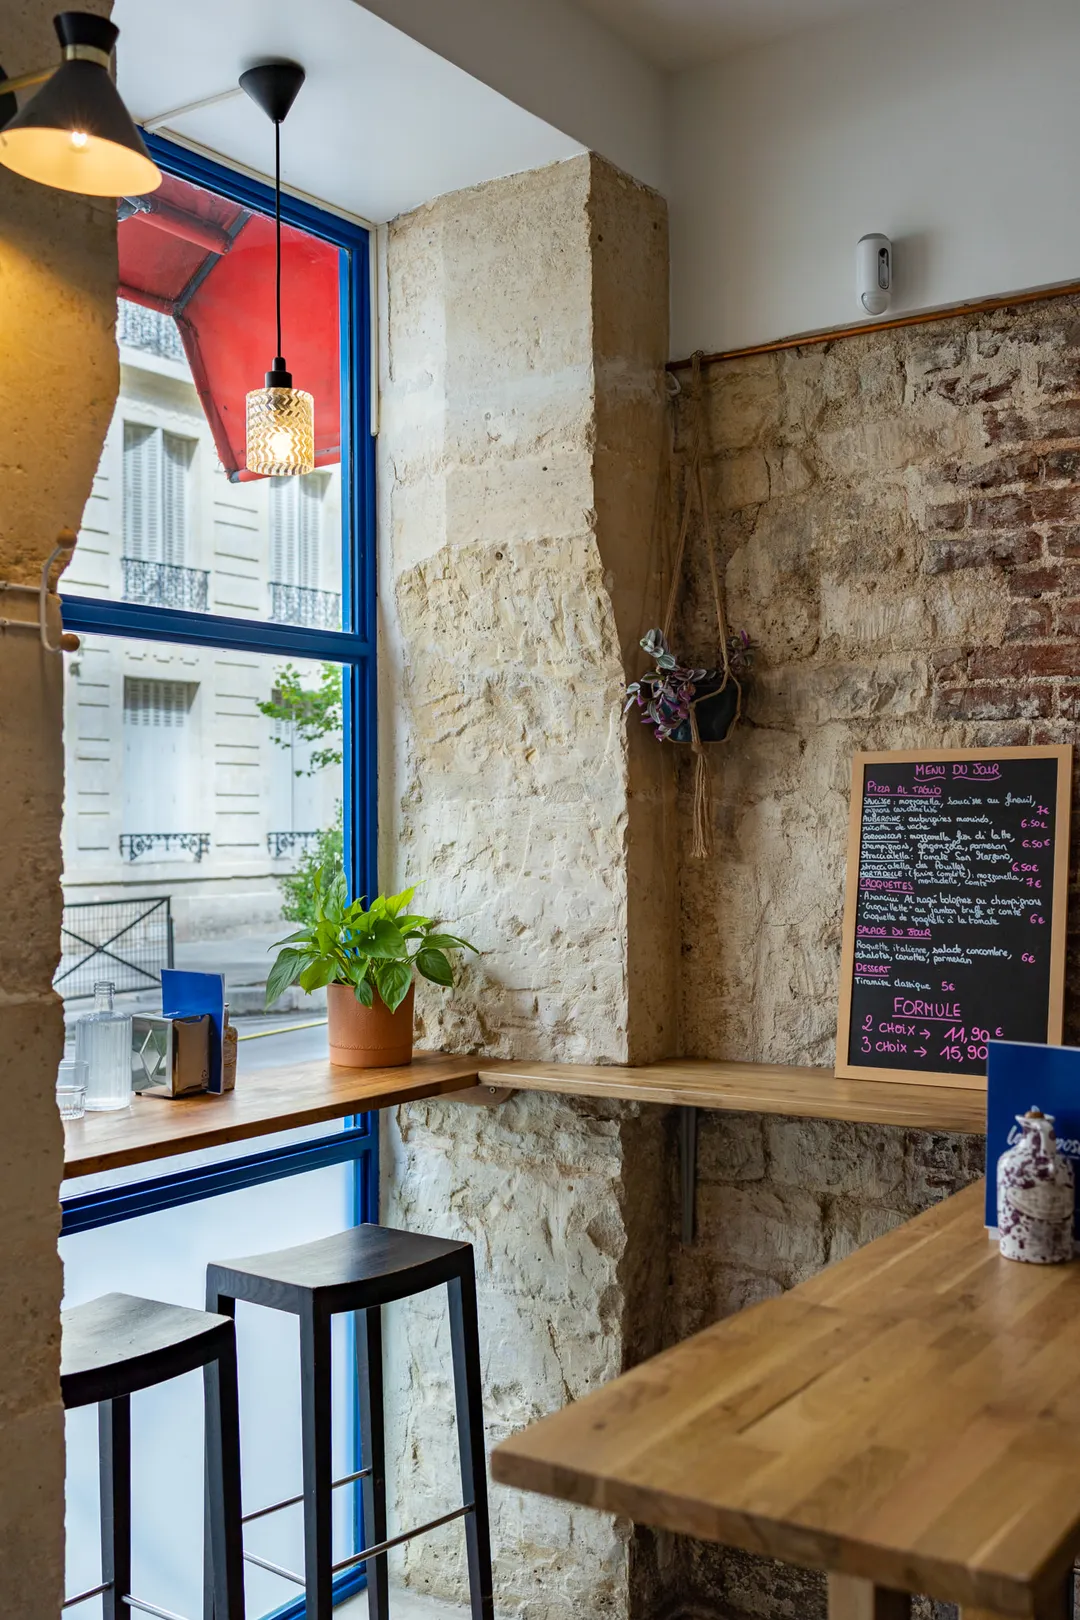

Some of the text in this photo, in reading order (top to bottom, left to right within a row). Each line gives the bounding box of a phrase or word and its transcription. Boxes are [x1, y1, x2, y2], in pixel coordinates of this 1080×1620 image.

[915, 762, 1000, 775] MENU DU JOUR
[897, 785, 908, 794] AL
[895, 823, 906, 831] de
[907, 822, 931, 830] vache
[1021, 819, 1048, 829] 6.50€
[975, 830, 986, 840] di
[1022, 838, 1051, 849] 6.50€
[955, 851, 971, 861] San
[860, 878, 914, 890] CROQUETTES
[929, 905, 957, 919] jambon
[987, 907, 995, 915] et
[899, 913, 908, 921] de
[947, 916, 955, 924] à
[957, 914, 967, 924] la
[1029, 913, 1045, 925] 6€
[857, 925, 932, 936] SALADE DU JOUR
[856, 940, 890, 952] Roquette
[966, 946, 1013, 960] concombre,
[1021, 952, 1036, 964] 6€
[856, 962, 891, 973] DESSERT
[941, 981, 956, 991] 5€
[894, 997, 961, 1017] FORMULE
[862, 1015, 873, 1032] 2
[943, 1026, 990, 1043] 11,90
[861, 1036, 872, 1053] 3
